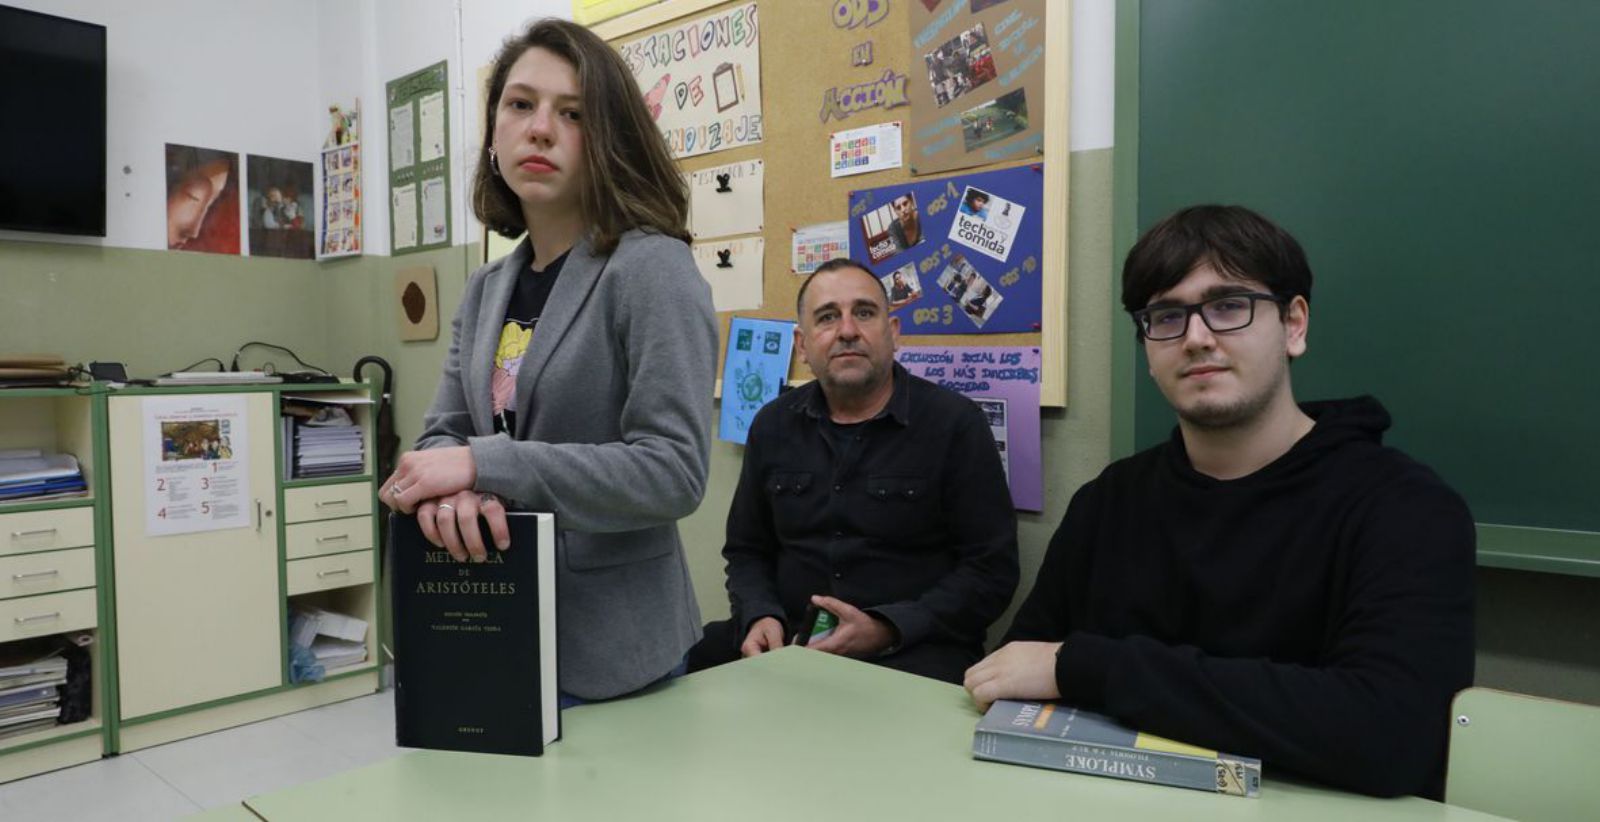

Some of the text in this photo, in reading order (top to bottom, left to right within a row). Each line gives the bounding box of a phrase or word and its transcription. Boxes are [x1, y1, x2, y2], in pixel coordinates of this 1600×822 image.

[621, 4, 757, 76] ESTACIONES
[674, 75, 704, 110] DE
[958, 215, 995, 239] techo
[957, 227, 1006, 256] comida
[941, 304, 954, 325] 3
[1000, 352, 1022, 366] LOS
[924, 367, 946, 377] LOS
[211, 462, 218, 472] 1
[157, 478, 166, 491] 2
[201, 477, 209, 490] 3
[157, 507, 166, 520] 4
[201, 502, 210, 514] 5
[416, 580, 516, 595] ARISTÓTELES
[1065, 754, 1156, 780] SYMPLOKE
